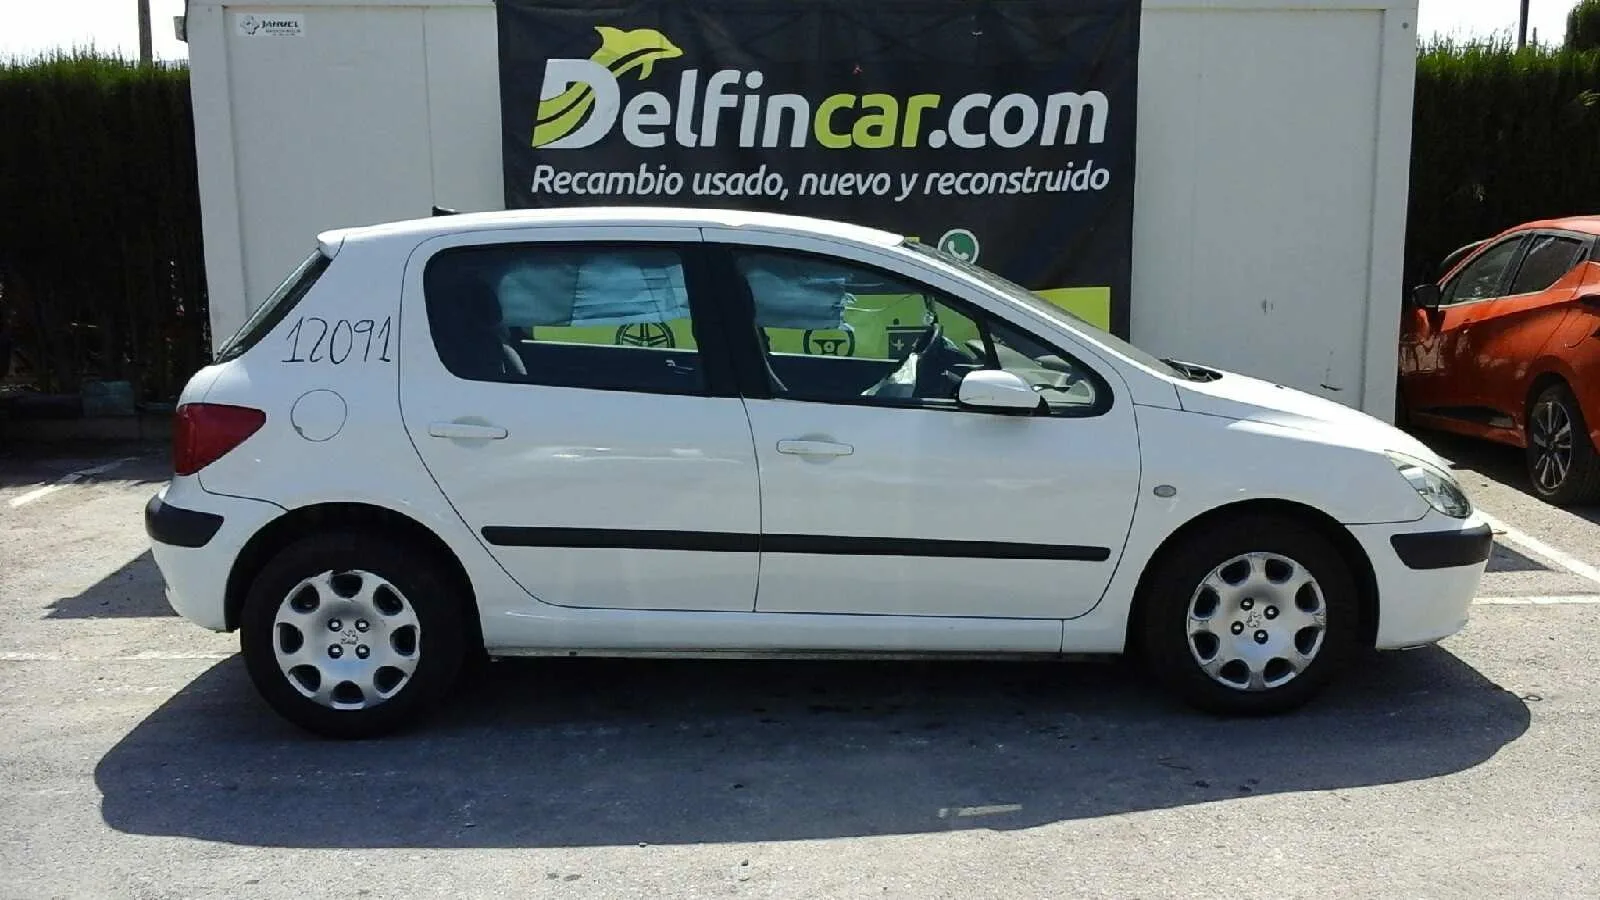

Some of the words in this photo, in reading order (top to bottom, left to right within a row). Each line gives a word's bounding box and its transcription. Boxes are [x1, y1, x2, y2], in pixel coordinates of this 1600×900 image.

[532, 58, 1109, 149] Delfincar.com
[532, 163, 684, 195] Recambio
[692, 164, 789, 200] usado,
[800, 172, 891, 196] nuevo
[895, 172, 919, 201] y
[924, 160, 1110, 195] reconstruido
[281, 315, 391, 364] 12091
